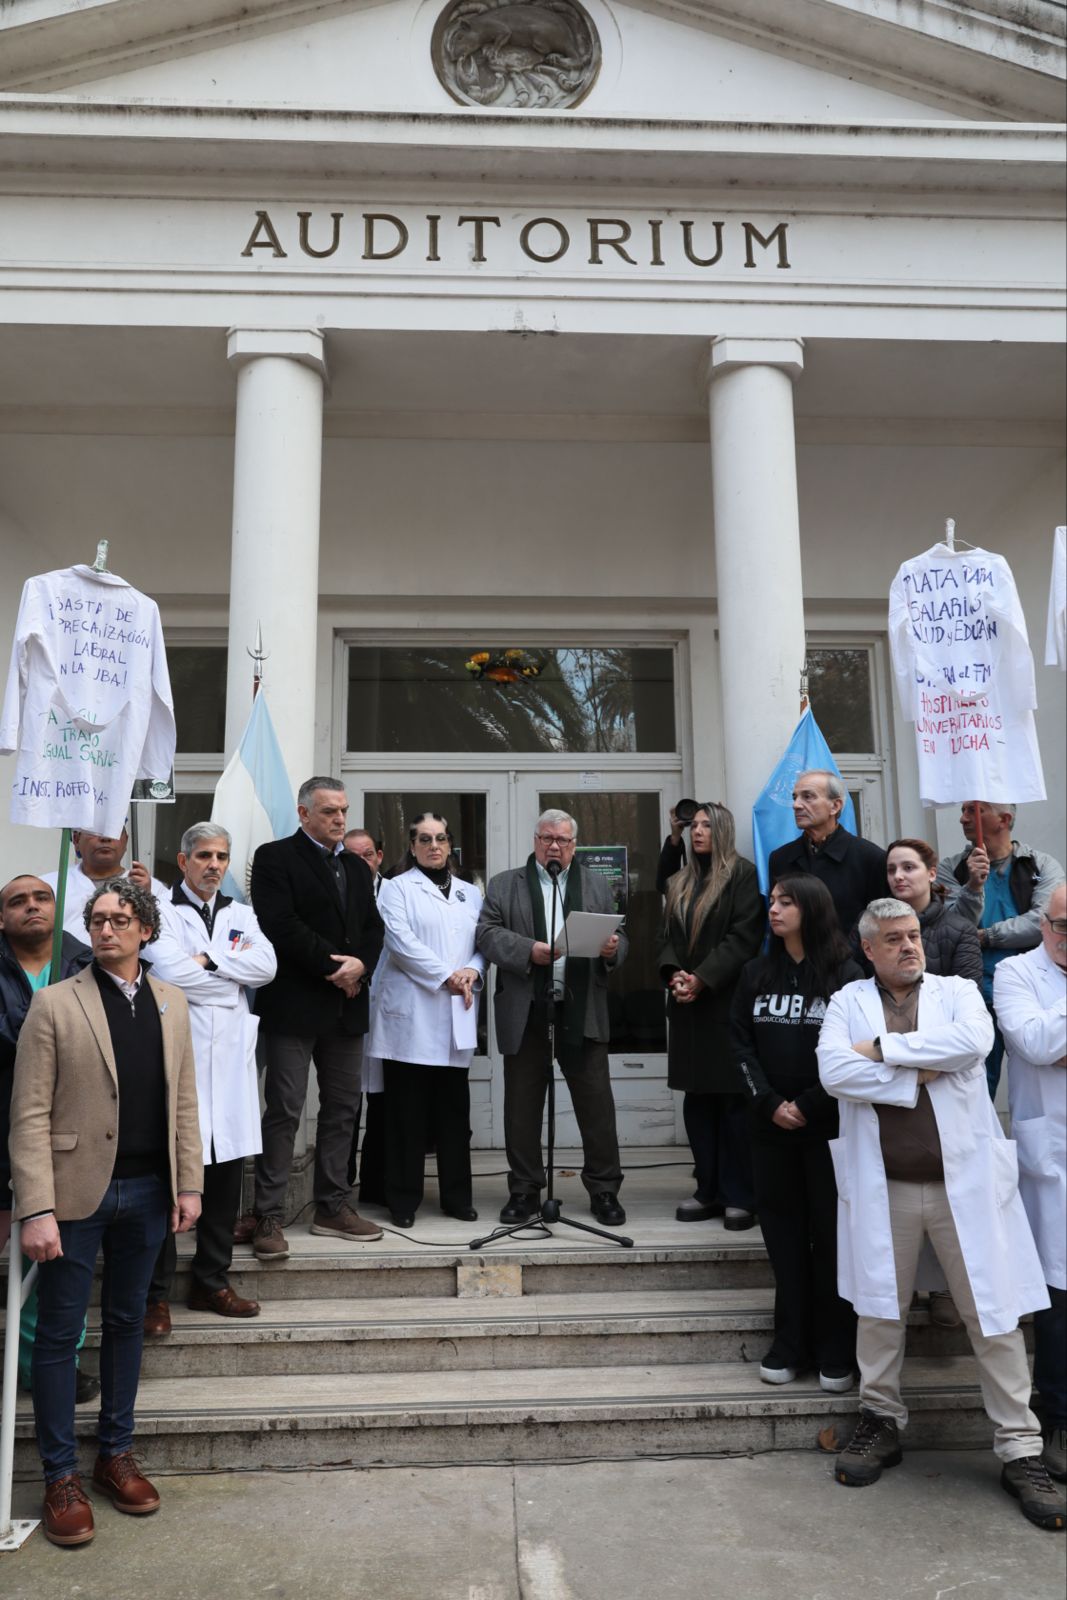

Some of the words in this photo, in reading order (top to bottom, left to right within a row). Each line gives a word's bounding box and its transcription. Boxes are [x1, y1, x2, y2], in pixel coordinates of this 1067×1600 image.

[240, 210, 791, 269] AUDITORIUM
[903, 569, 958, 594] PLATA
[115, 608, 134, 623] DE
[71, 661, 84, 674] LA
[43, 743, 73, 760] GUAL
[923, 739, 936, 755] EN
[56, 780, 90, 798] ROFFO
